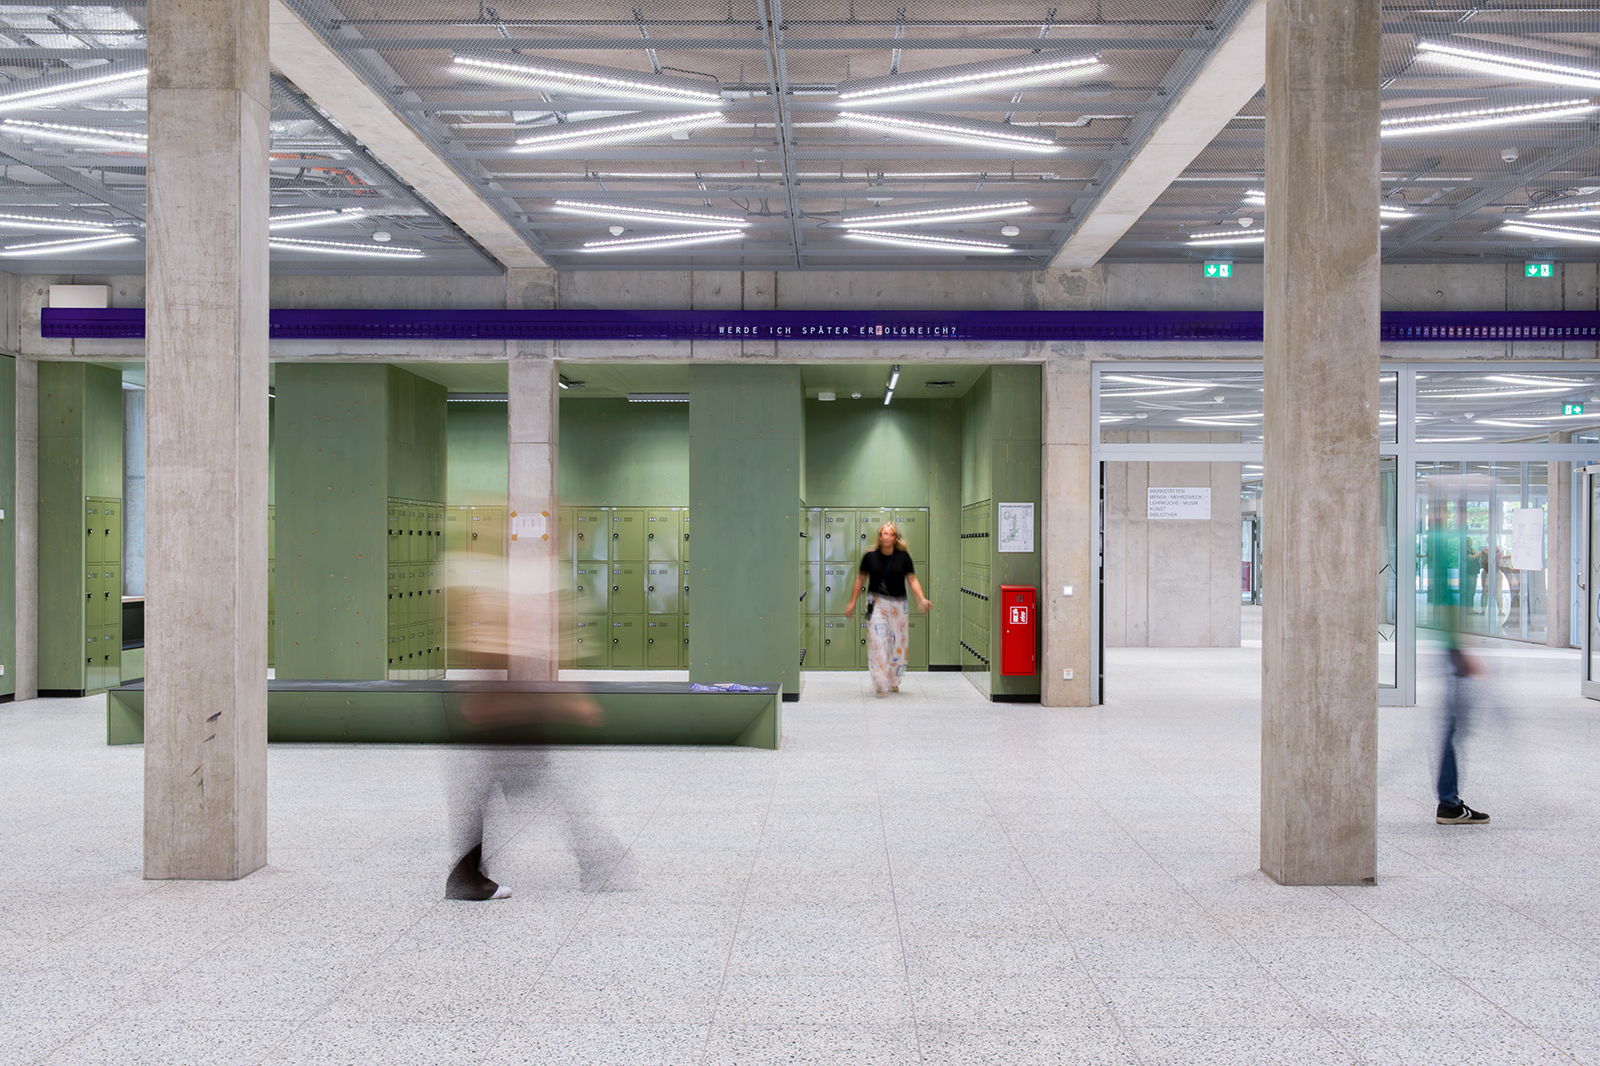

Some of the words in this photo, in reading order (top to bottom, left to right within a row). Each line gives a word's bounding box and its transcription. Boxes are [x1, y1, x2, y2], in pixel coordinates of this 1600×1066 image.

[718, 326, 758, 335] WERDE
[769, 326, 791, 335] ICH
[802, 325, 849, 335] SPÄTER
[859, 325, 957, 335] ERFOLGREICH?
